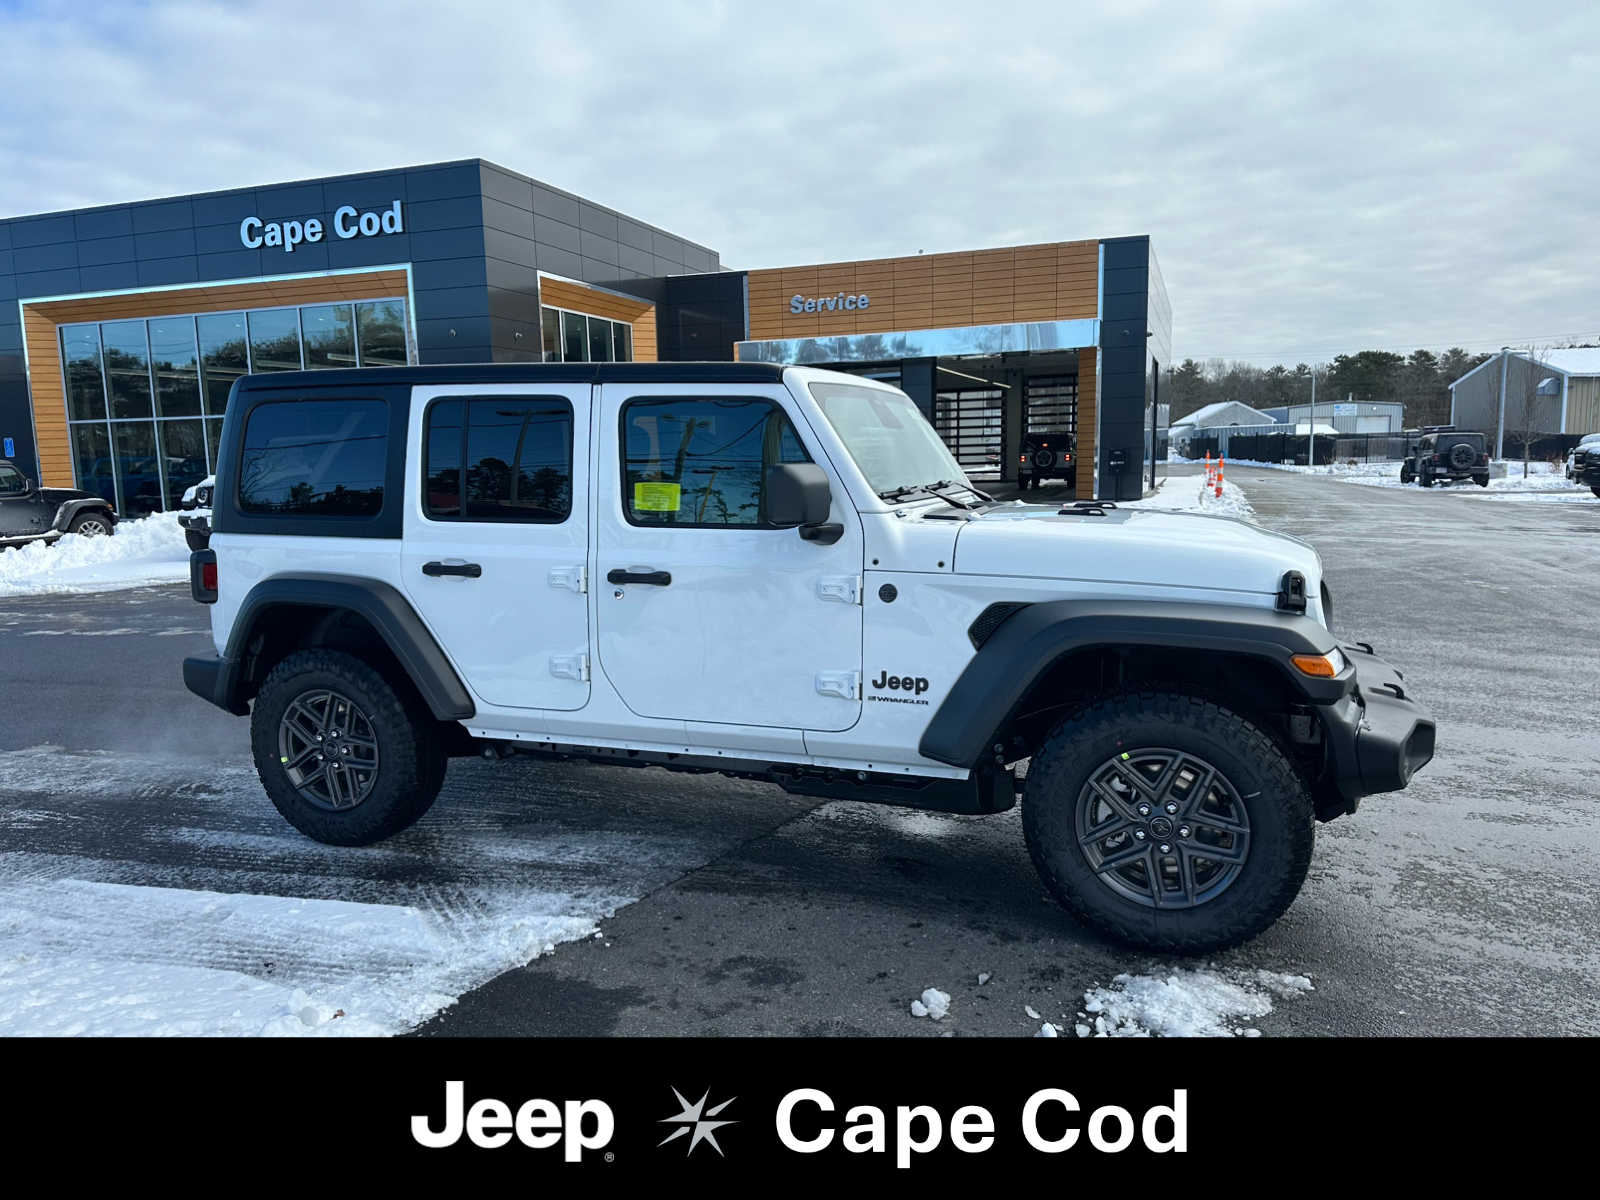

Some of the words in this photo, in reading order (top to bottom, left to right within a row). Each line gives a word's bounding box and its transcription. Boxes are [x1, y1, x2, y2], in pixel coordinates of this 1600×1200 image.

[240, 216, 323, 252] Cape
[333, 200, 404, 239] Cod
[790, 292, 870, 314] Service
[871, 670, 929, 695] Jeep
[877, 696, 929, 705] WRANGLER
